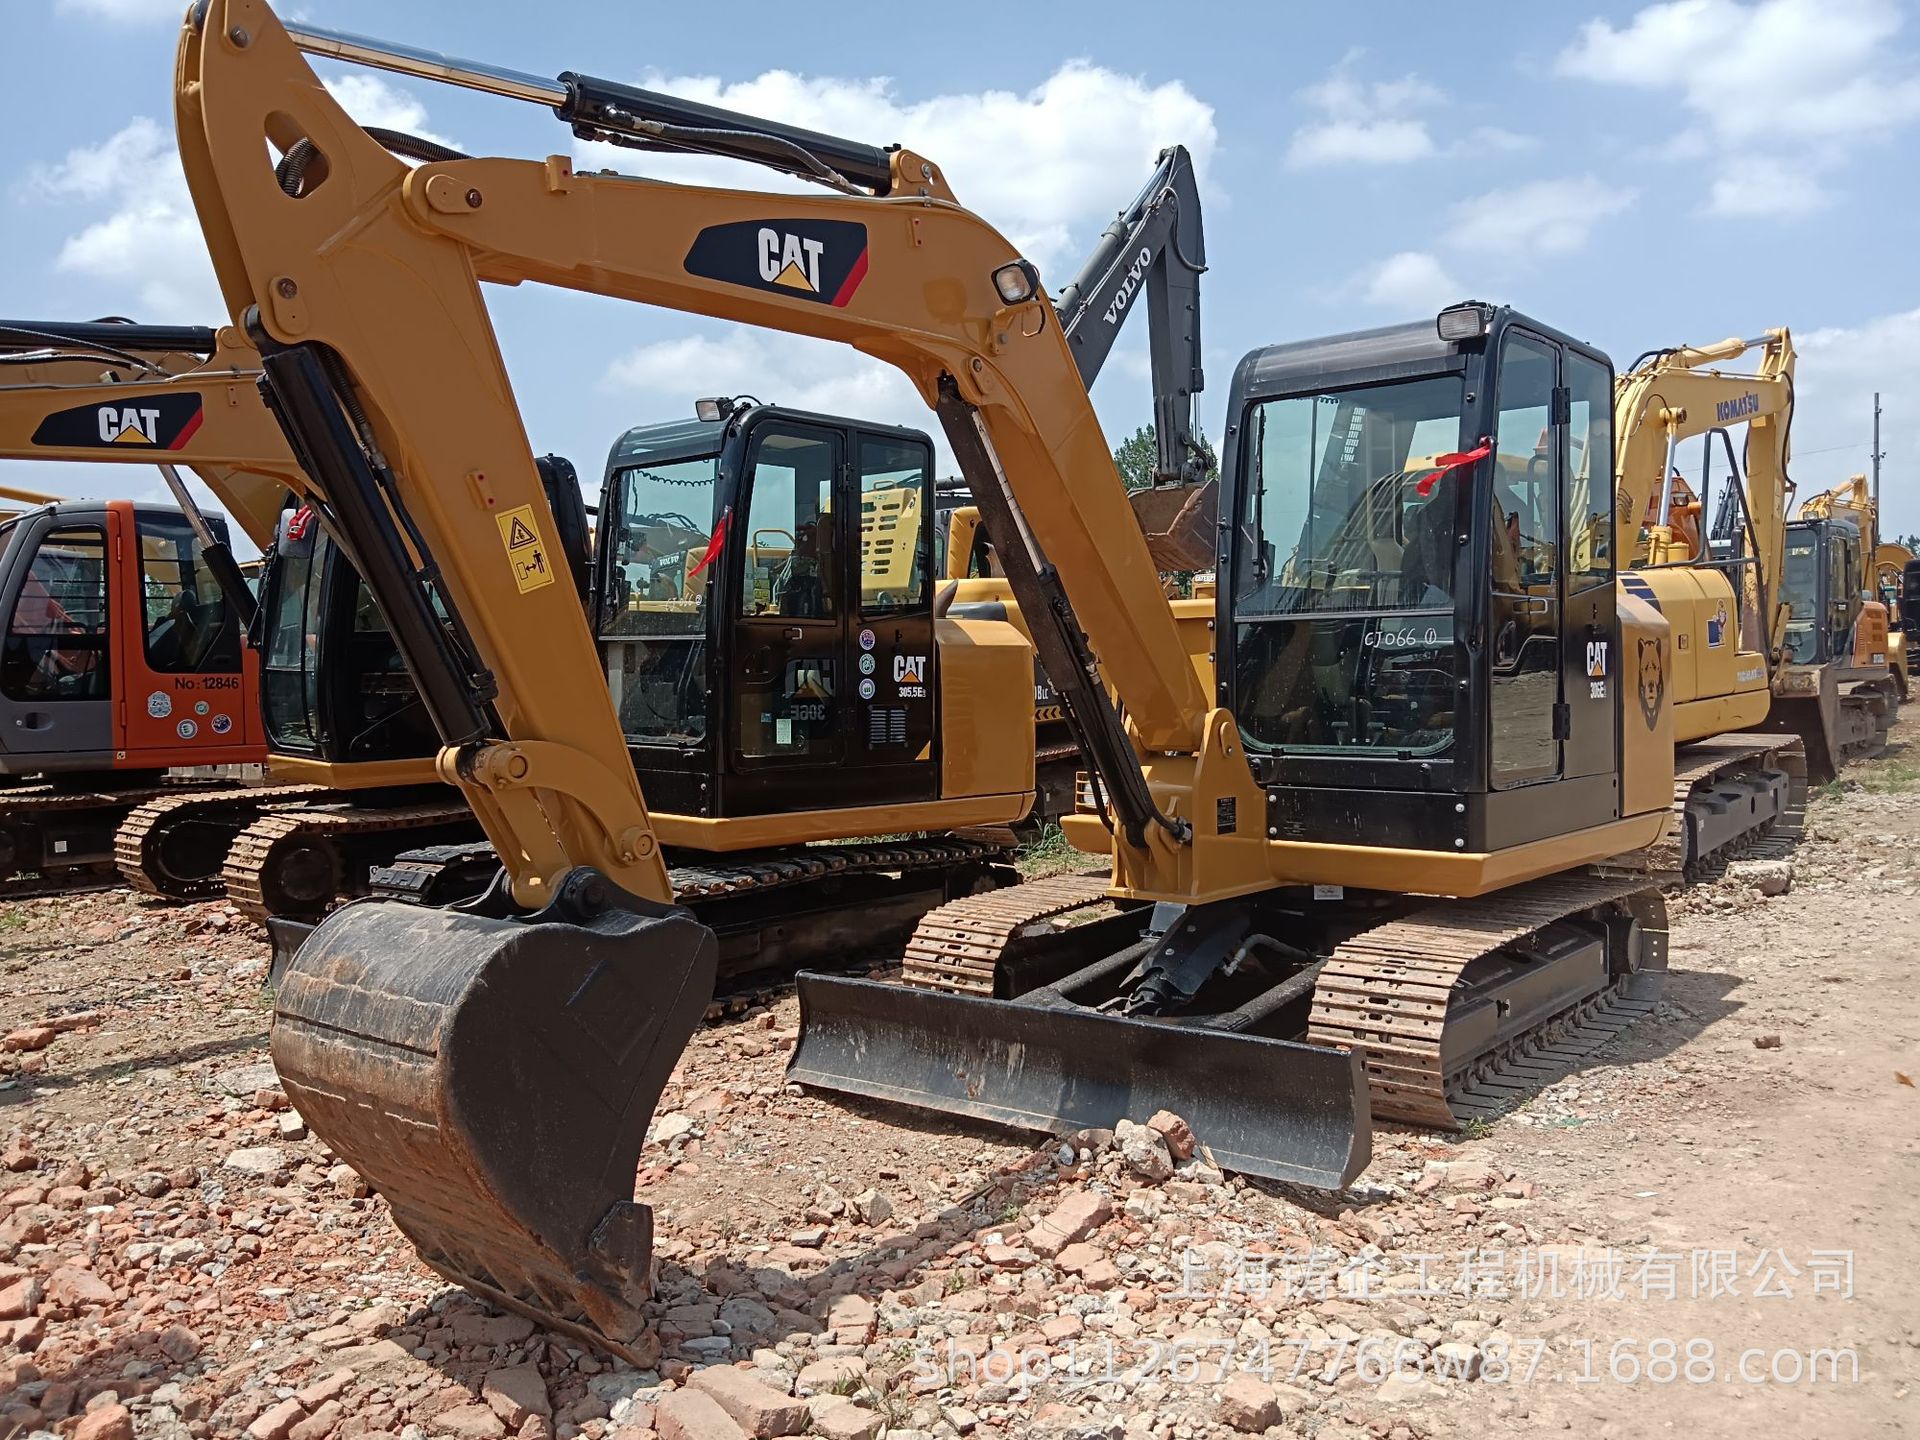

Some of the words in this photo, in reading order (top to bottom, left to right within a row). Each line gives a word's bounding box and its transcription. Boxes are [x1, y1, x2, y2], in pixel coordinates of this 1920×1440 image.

[758, 227, 824, 293] CAT
[1102, 247, 1151, 325] VOLVO
[1716, 390, 1759, 422] KOMATSU
[98, 406, 160, 444] CAT
[1364, 627, 1416, 648] CJ066
[893, 655, 926, 683] CAT
[1586, 641, 1608, 677] CAT
[202, 677, 239, 690] 12846
